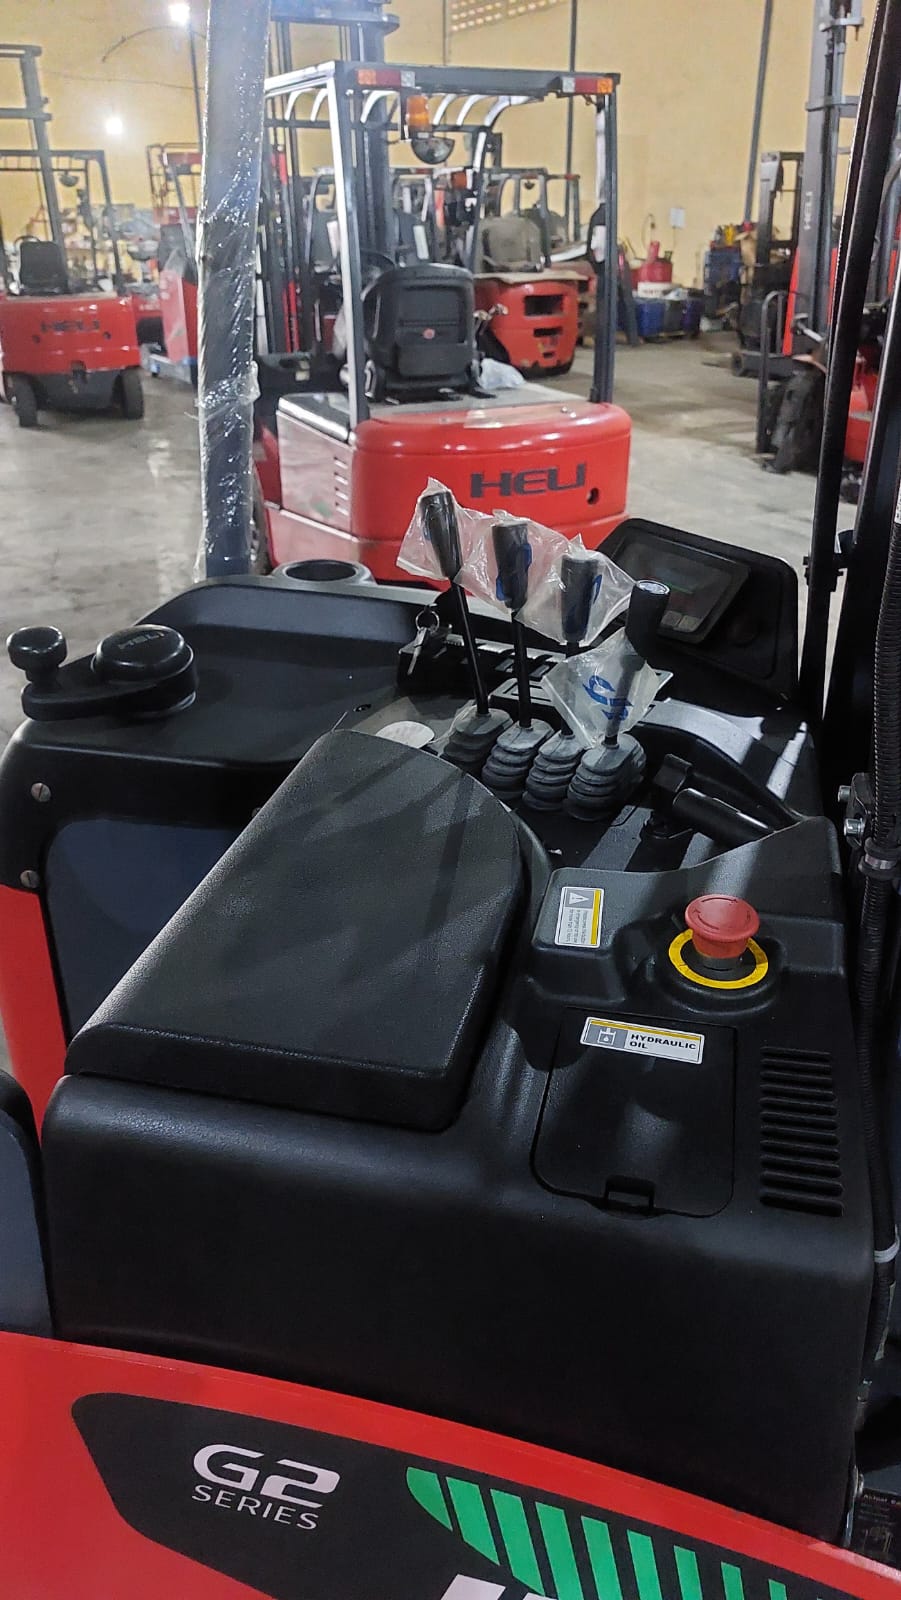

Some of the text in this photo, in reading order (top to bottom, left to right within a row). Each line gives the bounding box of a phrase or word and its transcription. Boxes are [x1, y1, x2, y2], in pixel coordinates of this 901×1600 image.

[803, 191, 813, 230] HELI
[470, 463, 586, 498] HELI
[629, 1041, 649, 1049] OIL
[630, 1033, 697, 1050] HYDRAULIC
[193, 1444, 341, 1508] G2
[191, 1485, 319, 1530] SERIES
